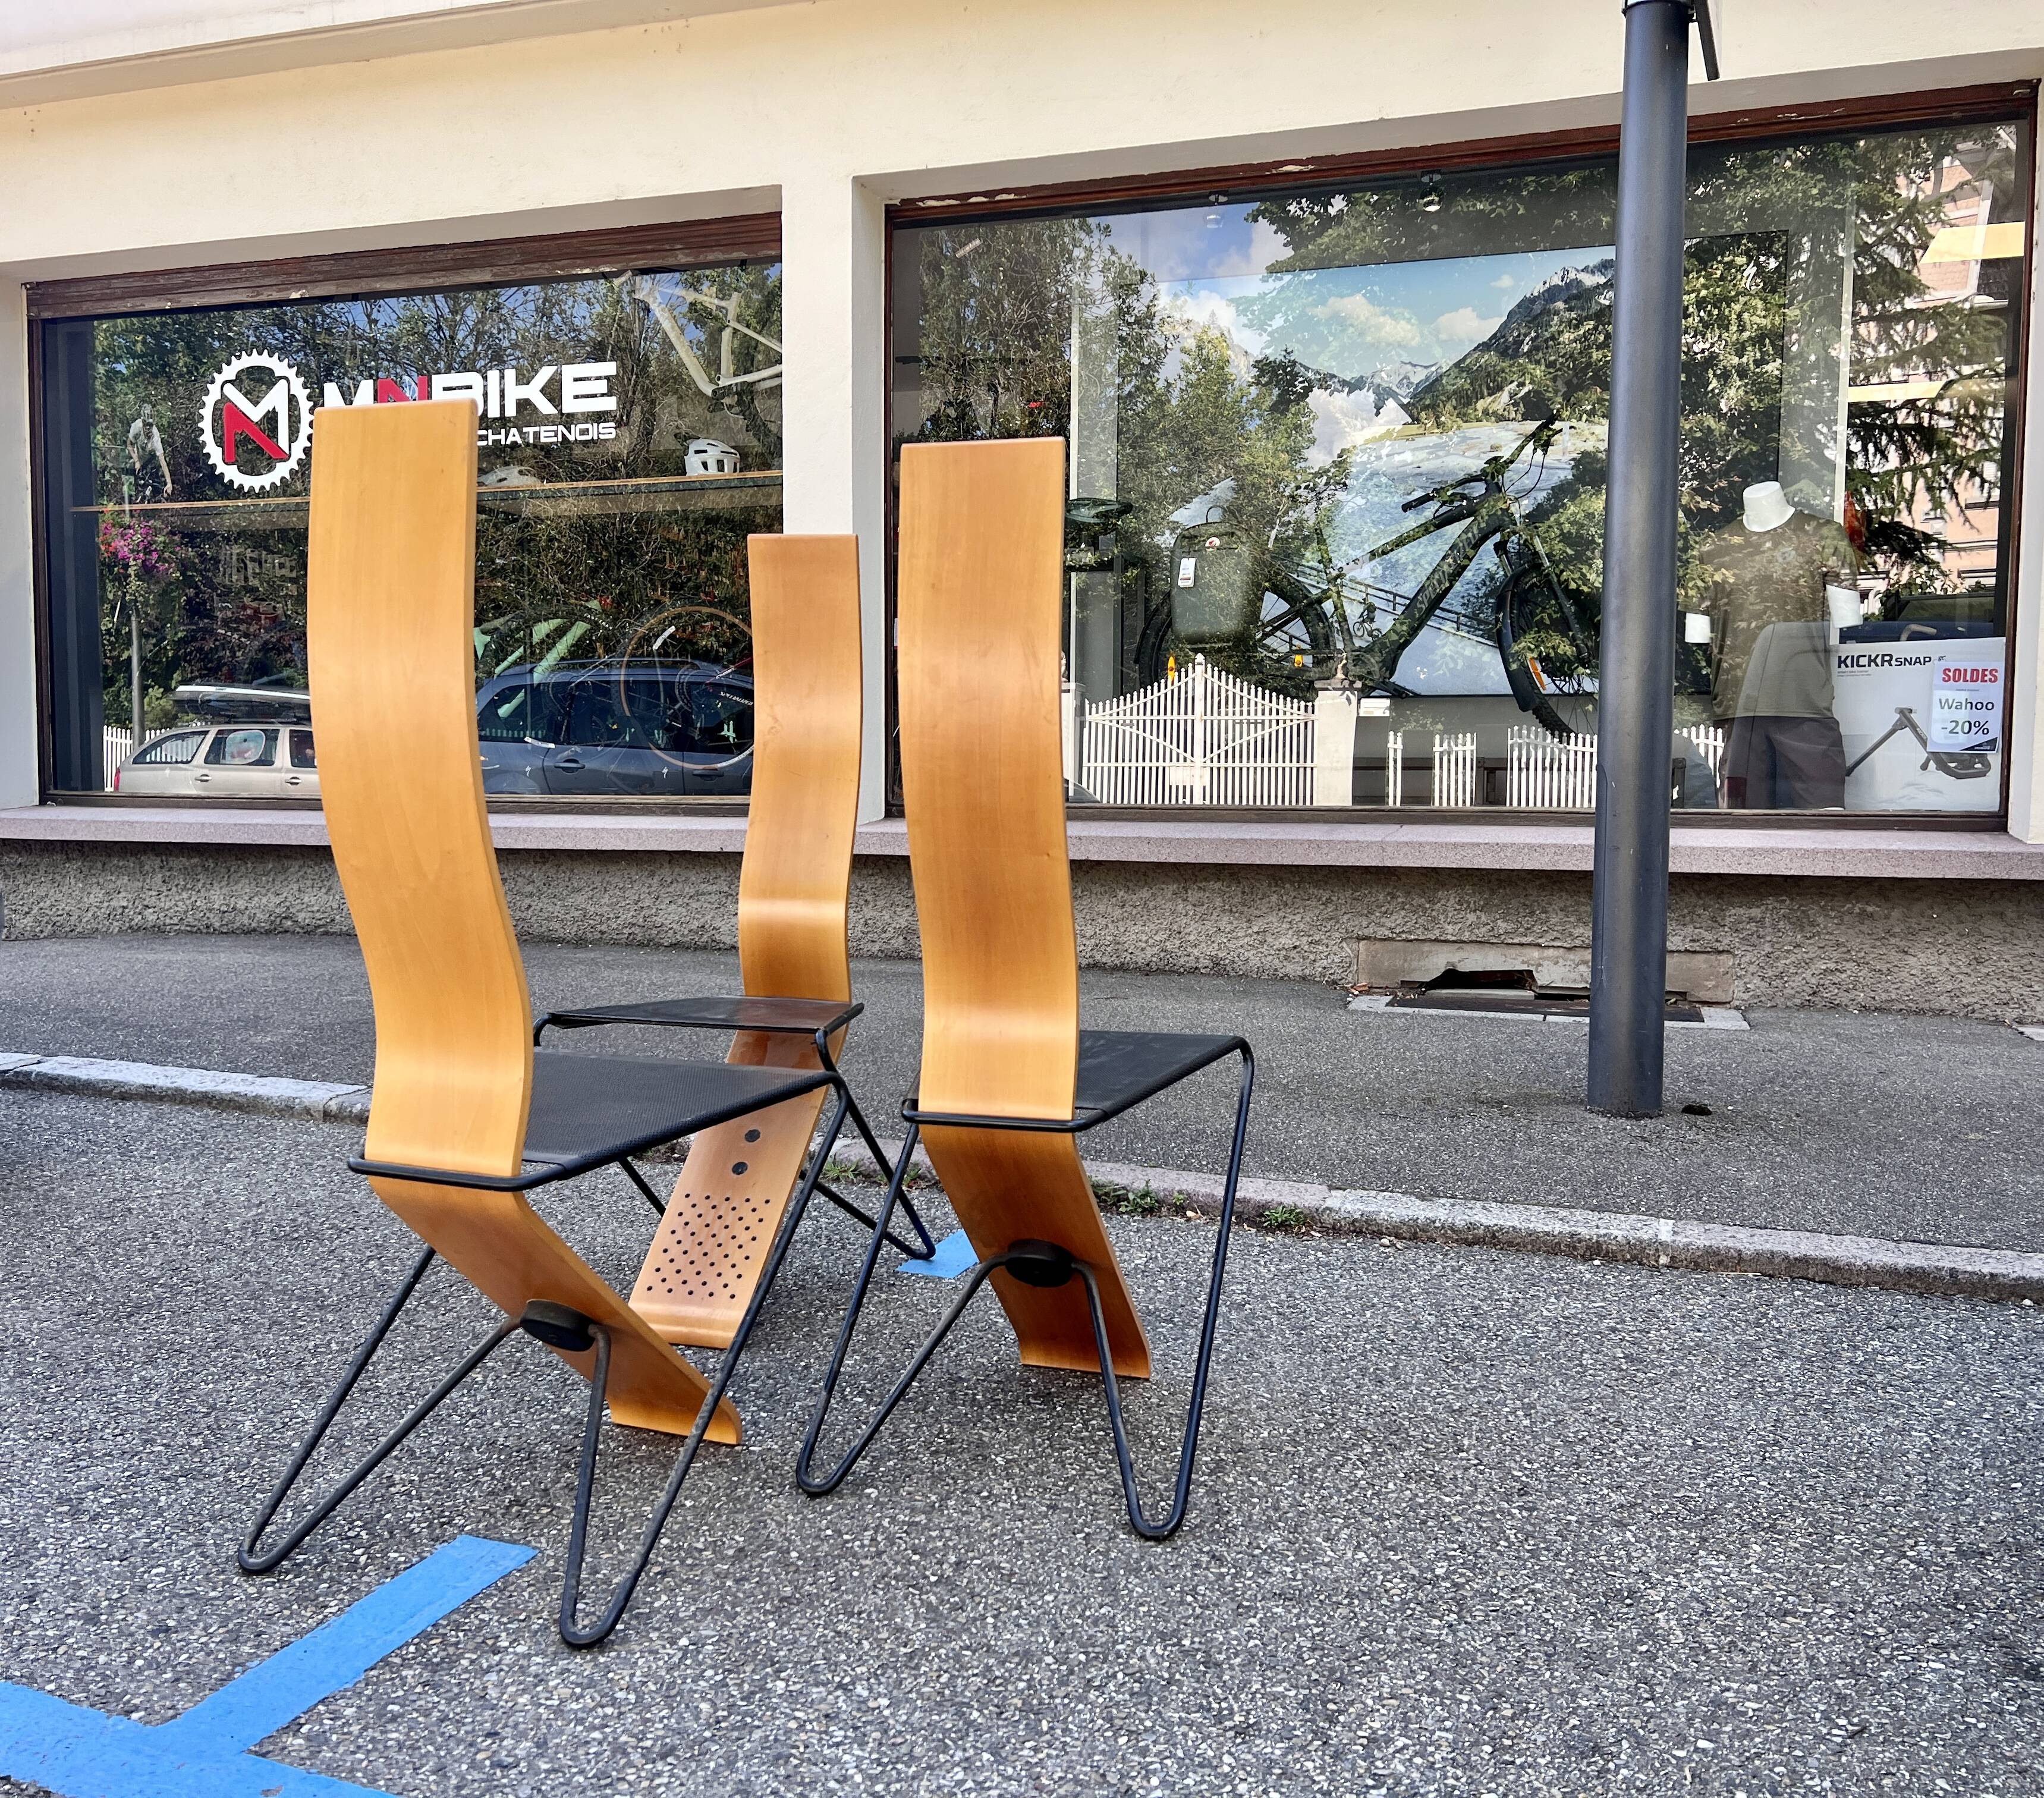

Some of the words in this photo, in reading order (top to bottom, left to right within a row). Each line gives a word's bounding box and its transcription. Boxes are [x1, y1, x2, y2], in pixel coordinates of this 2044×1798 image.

[477, 422, 616, 446] CHATENOIS
[1838, 654, 1893, 668] KICKR
[1895, 656, 1932, 667] SNAP
[1942, 668, 1998, 683] SOLDES
[1939, 698, 1995, 711] Wahoo
[1941, 720, 1989, 735] -20%
